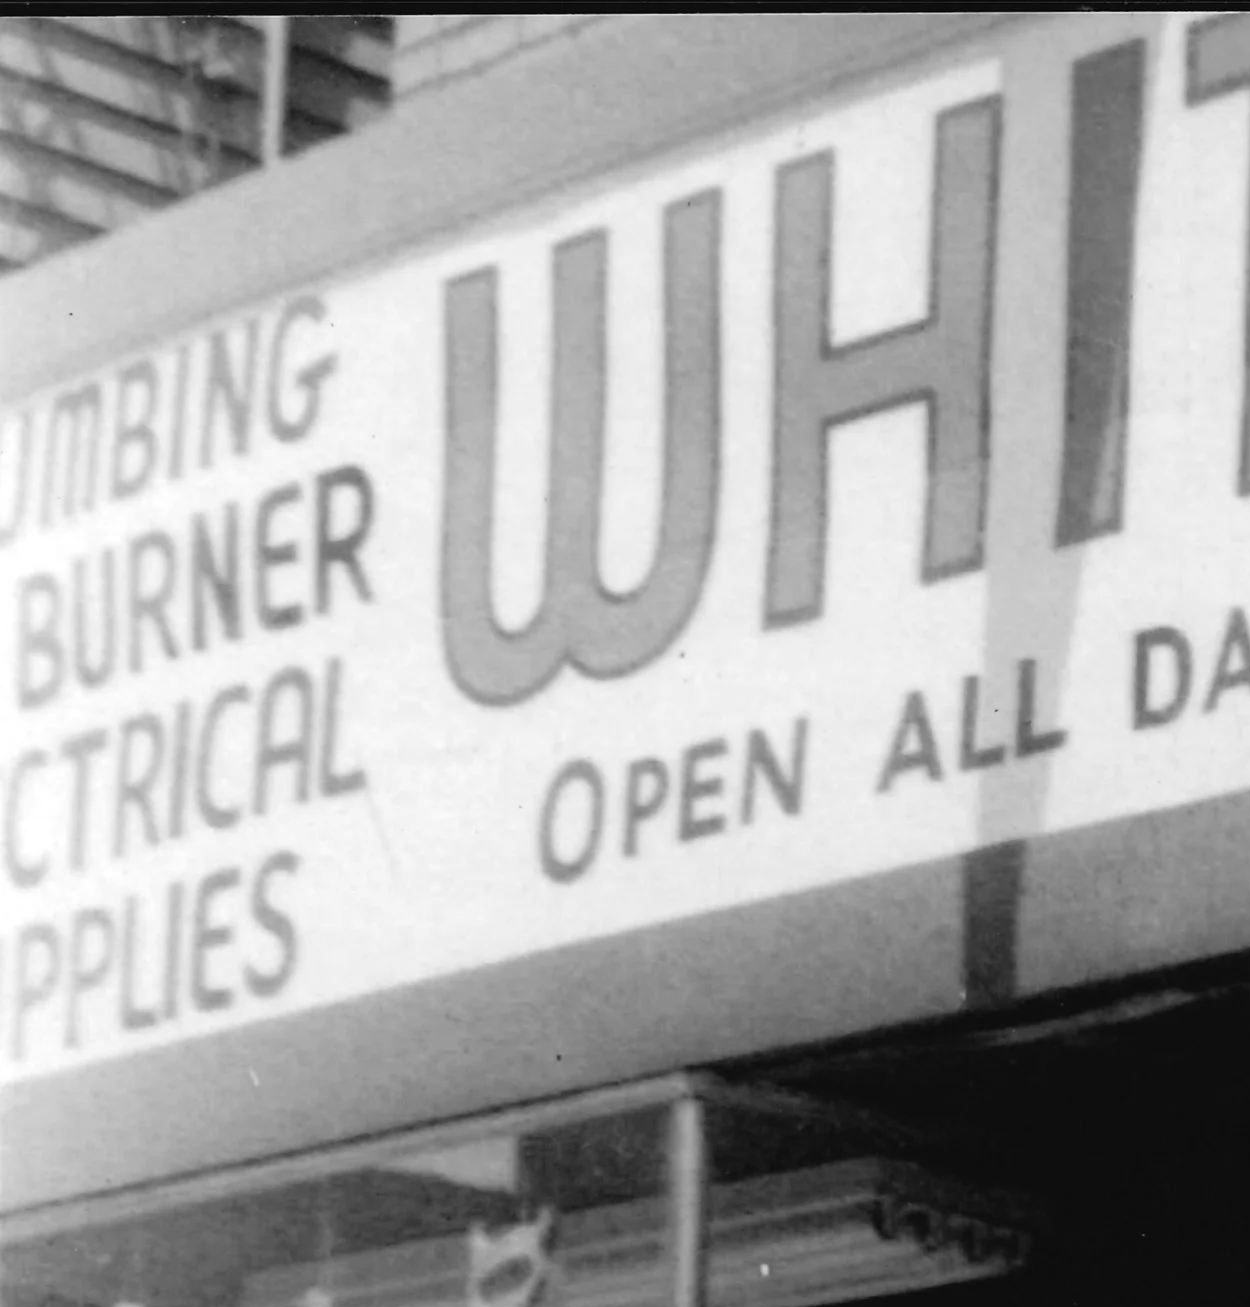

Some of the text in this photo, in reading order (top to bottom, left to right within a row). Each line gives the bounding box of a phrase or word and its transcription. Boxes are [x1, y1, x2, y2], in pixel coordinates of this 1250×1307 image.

[18, 464, 375, 711] BURNER
[5, 656, 367, 890] CTRICAL
[538, 717, 809, 884] OPEN
[877, 656, 1067, 793] ALL
[10, 850, 300, 1060] PPLIES
